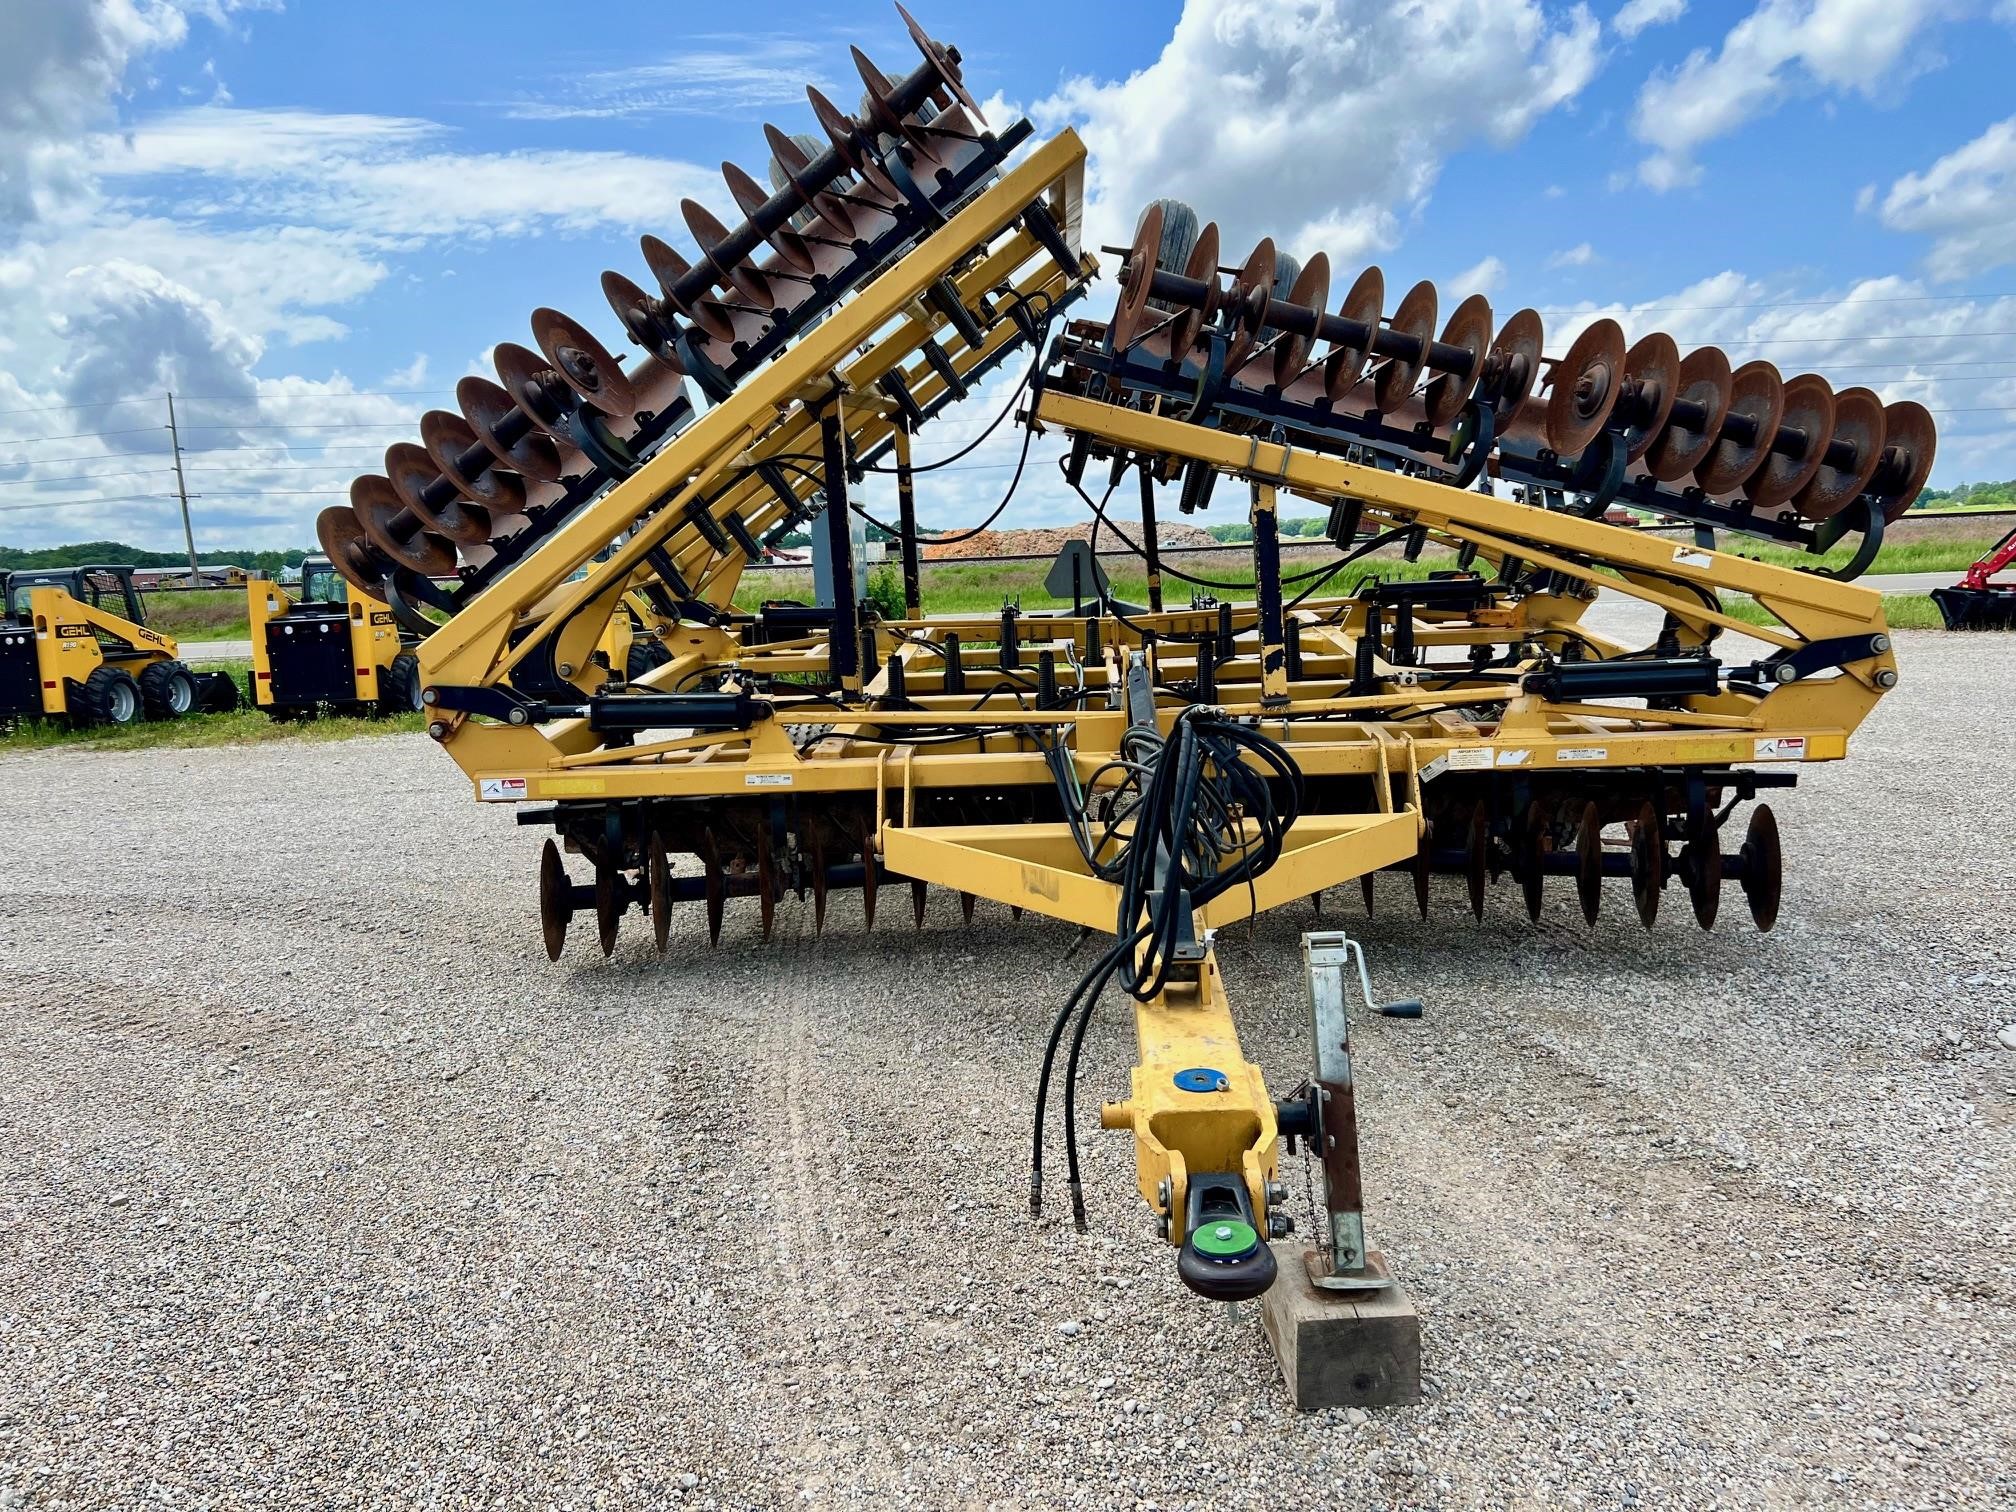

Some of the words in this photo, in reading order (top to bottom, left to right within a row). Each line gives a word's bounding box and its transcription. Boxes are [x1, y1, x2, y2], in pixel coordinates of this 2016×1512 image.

[374, 613, 393, 624] GEHL
[61, 626, 90, 637] GEHL
[138, 628, 166, 647] GEHL
